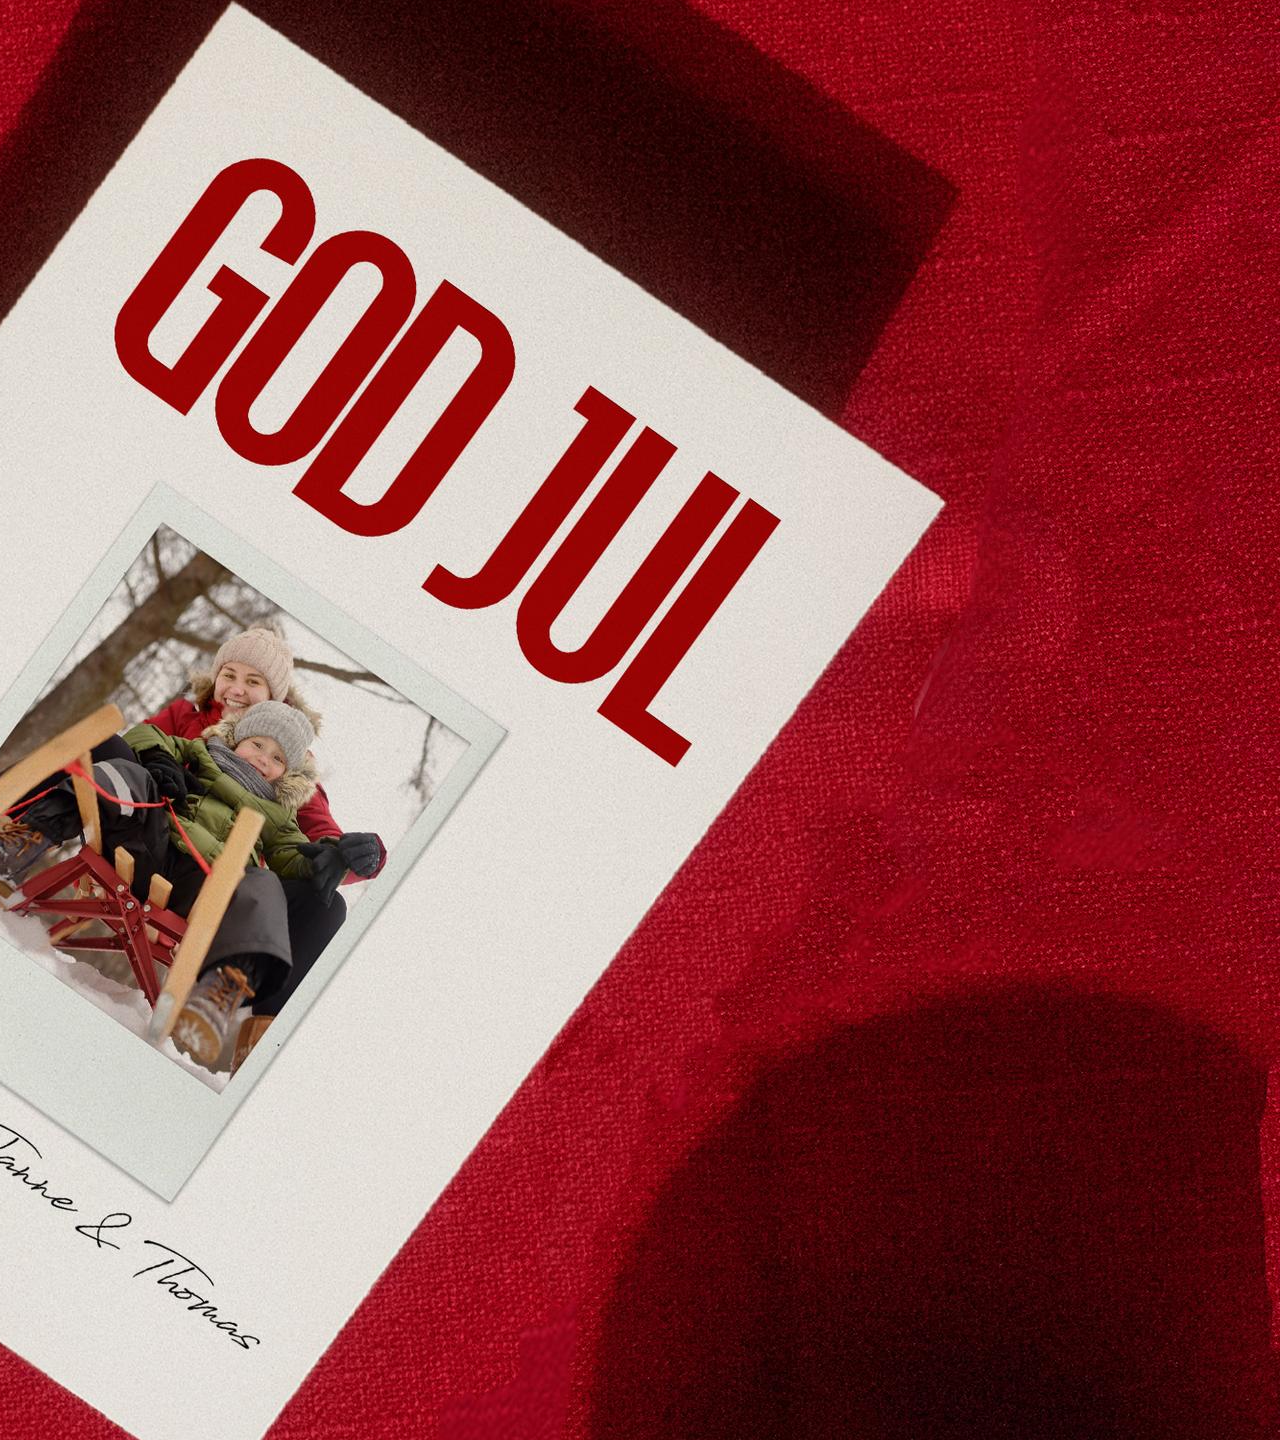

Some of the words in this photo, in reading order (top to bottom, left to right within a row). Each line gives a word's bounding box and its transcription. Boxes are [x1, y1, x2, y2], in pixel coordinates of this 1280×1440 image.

[114, 157, 516, 538] GOD
[420, 384, 782, 769] JUL
[74, 1212, 133, 1251] &
[131, 1239, 262, 1351] Thomas
